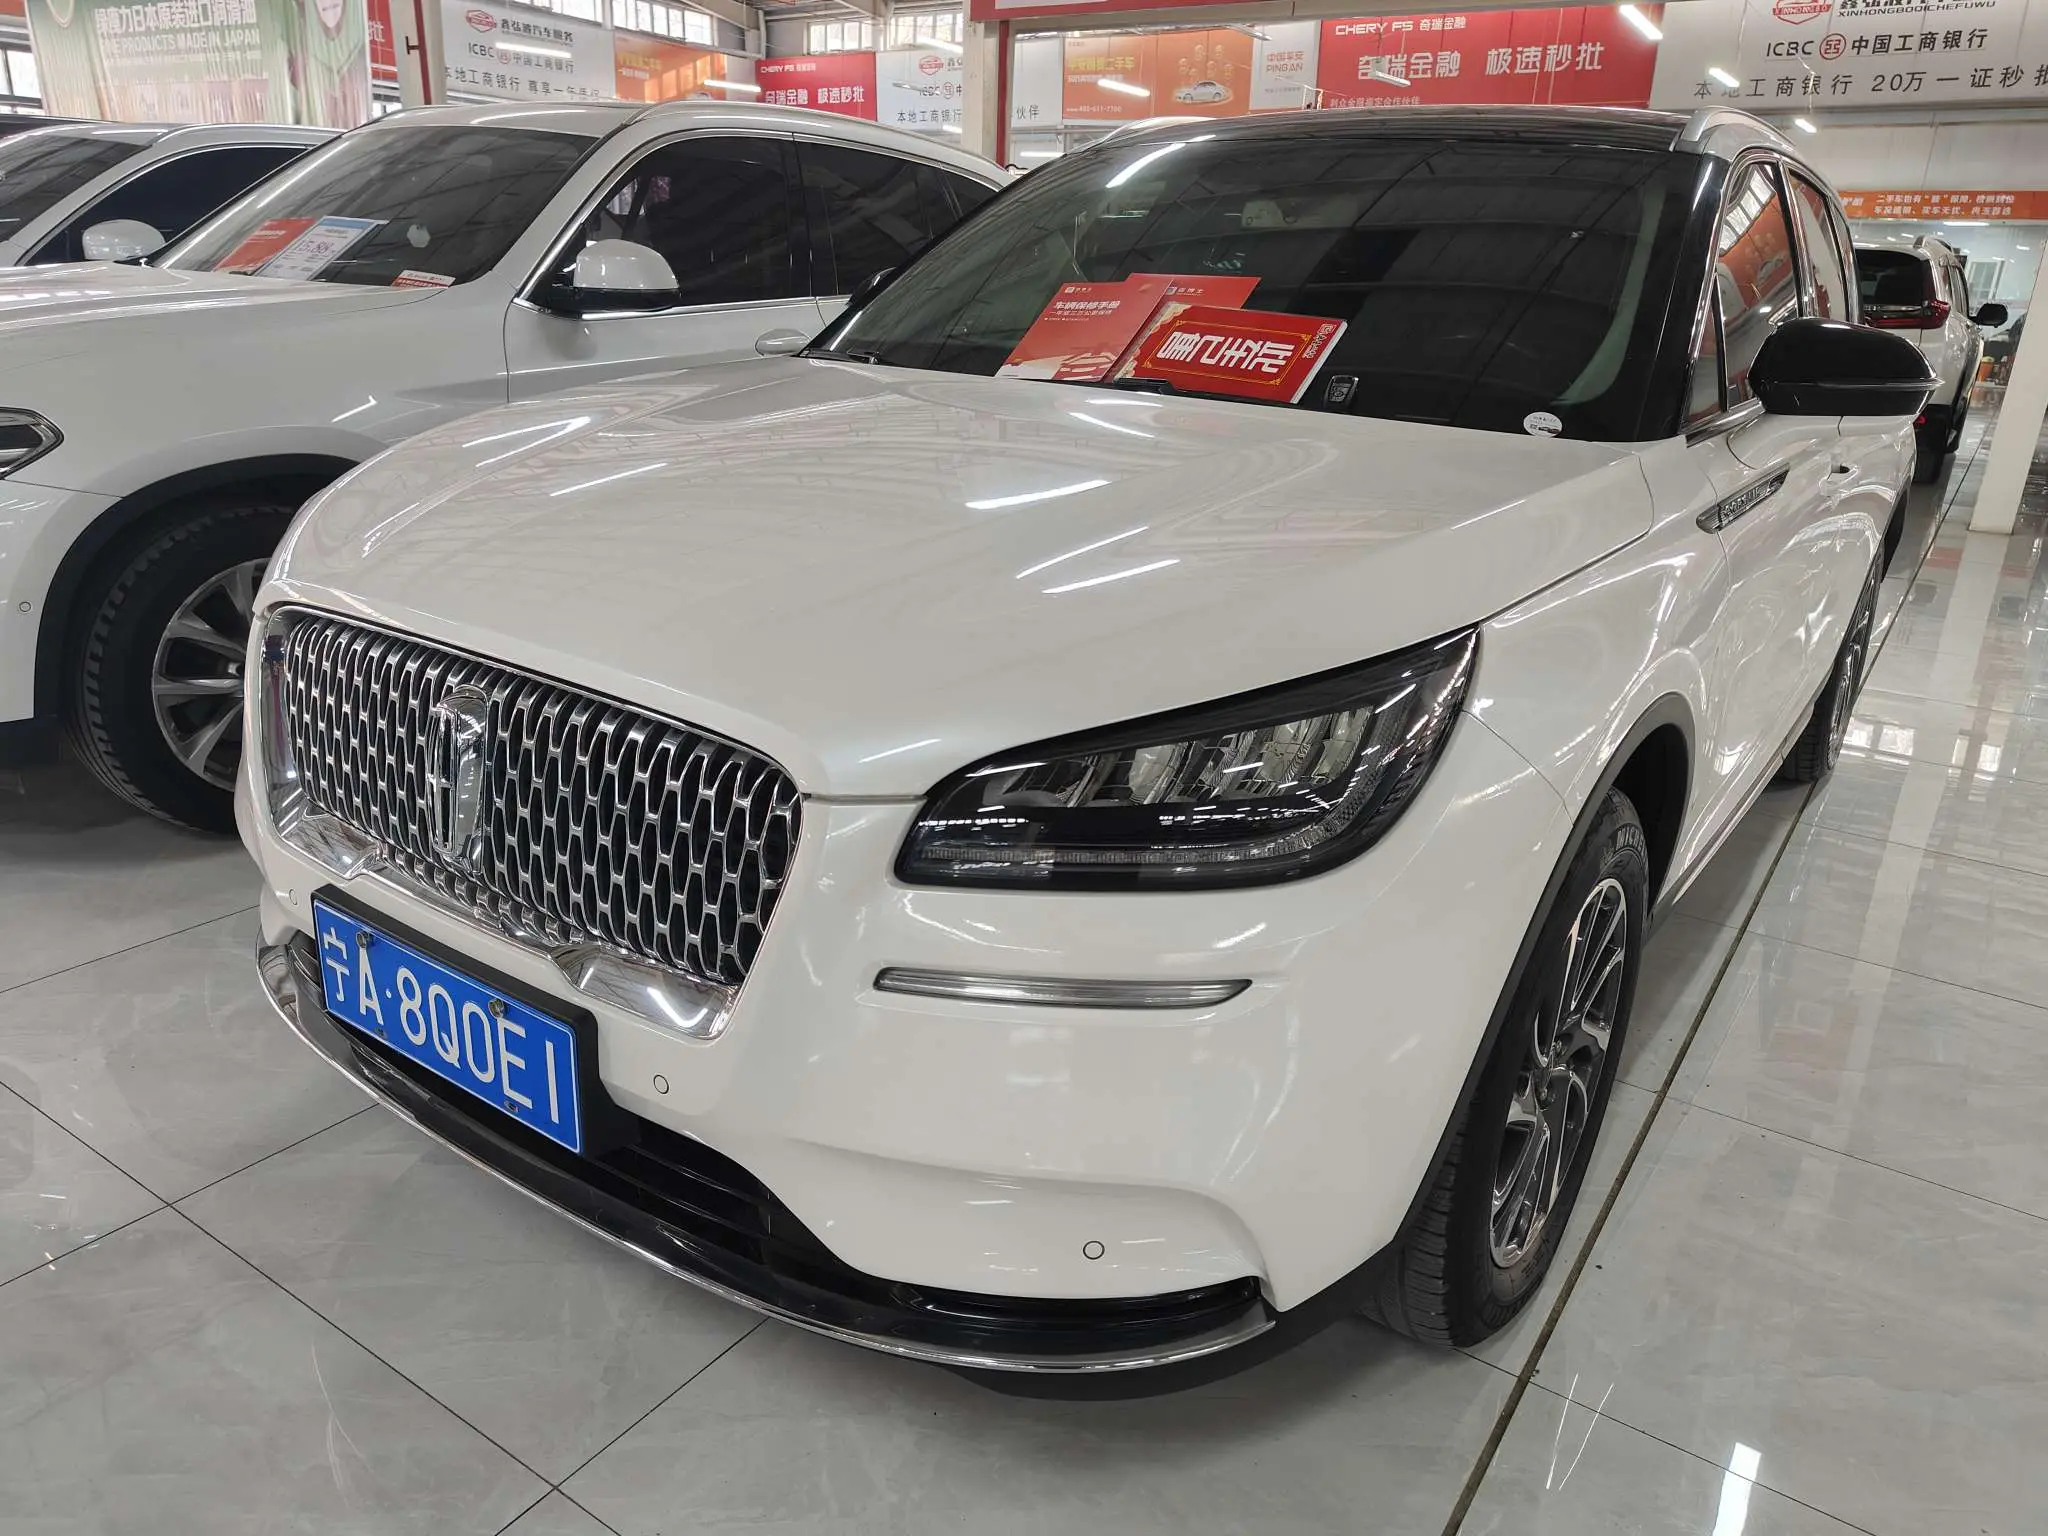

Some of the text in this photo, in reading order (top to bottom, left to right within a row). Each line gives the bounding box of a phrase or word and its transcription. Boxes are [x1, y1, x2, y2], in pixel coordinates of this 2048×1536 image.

[1335, 16, 1467, 35] CHERY FS 奇瑞金融
[177, 32, 207, 50] MADE
[224, 29, 260, 46] JAPAN
[468, 42, 494, 58] ICBC
[1766, 28, 1989, 57] ICBC 中国工商银行
[1485, 42, 1604, 75] 极速秒批
